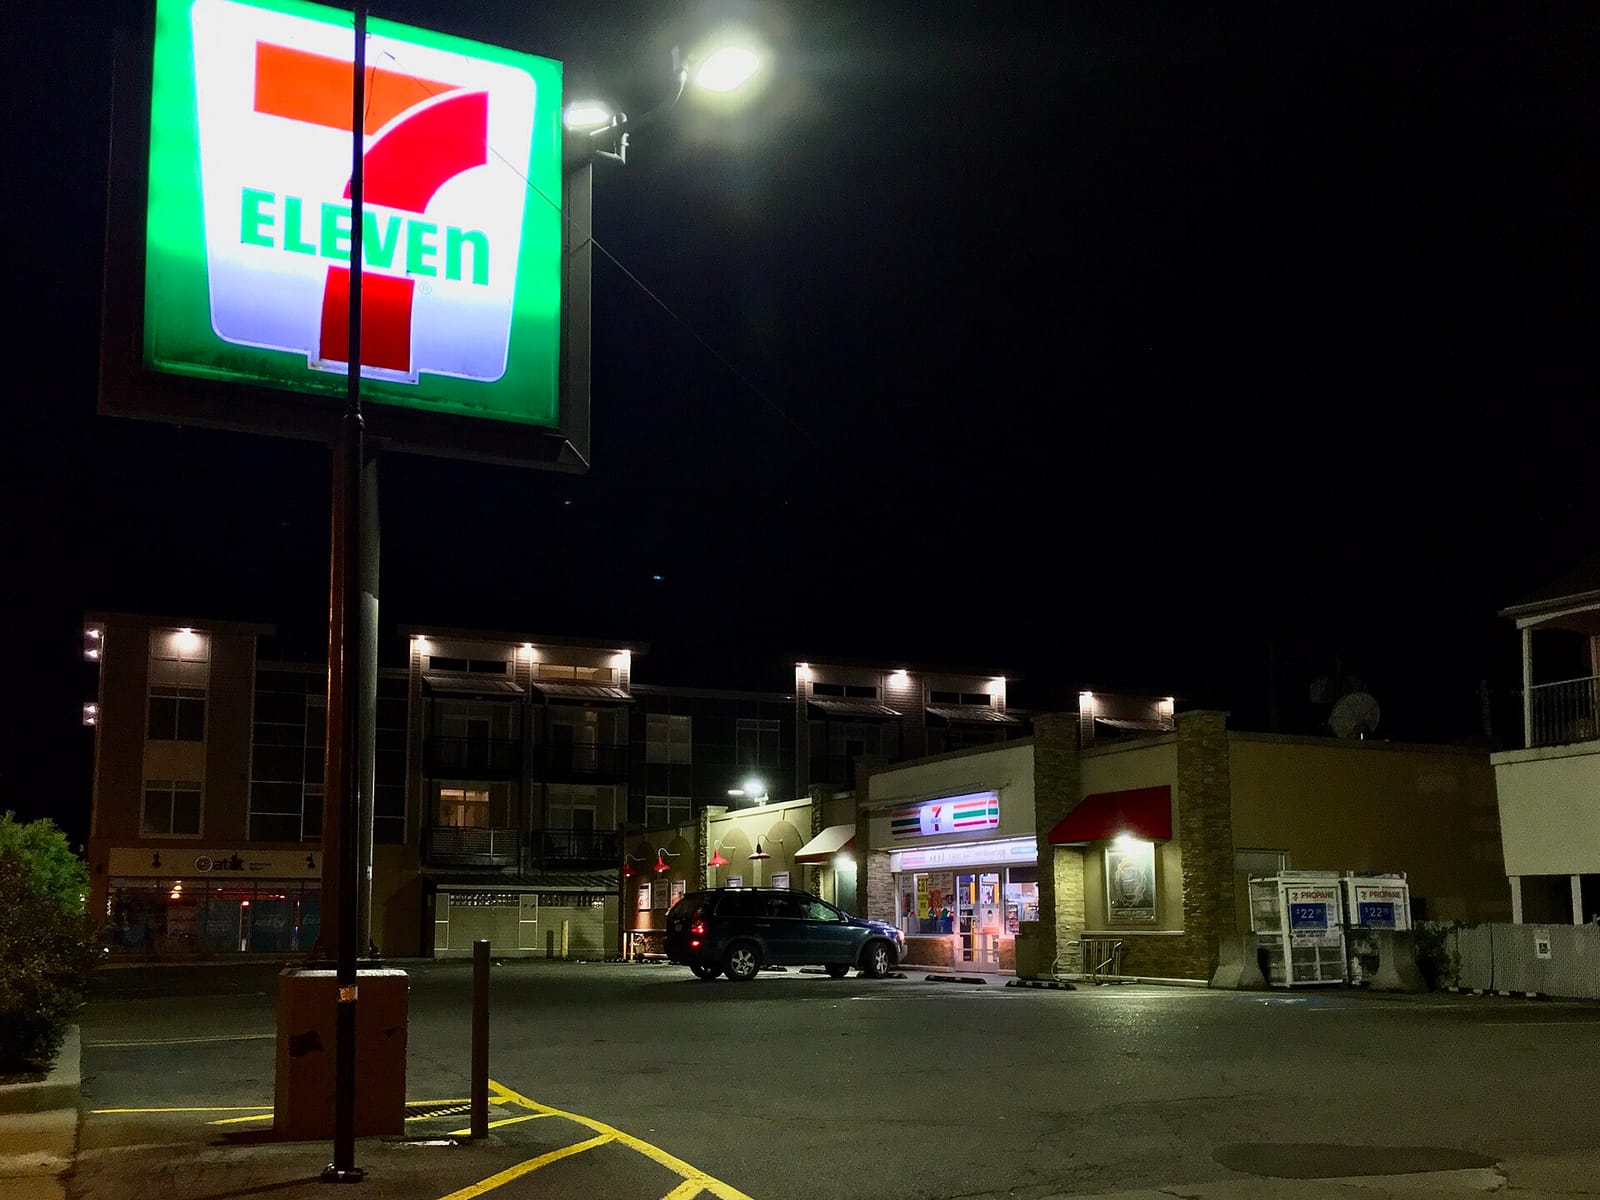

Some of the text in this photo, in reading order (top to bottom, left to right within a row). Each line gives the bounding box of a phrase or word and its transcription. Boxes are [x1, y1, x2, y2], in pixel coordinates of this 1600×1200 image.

[253, 40, 490, 374] 7
[1301, 891, 1335, 899] PROPANE
[1369, 890, 1402, 899] PROPANE
